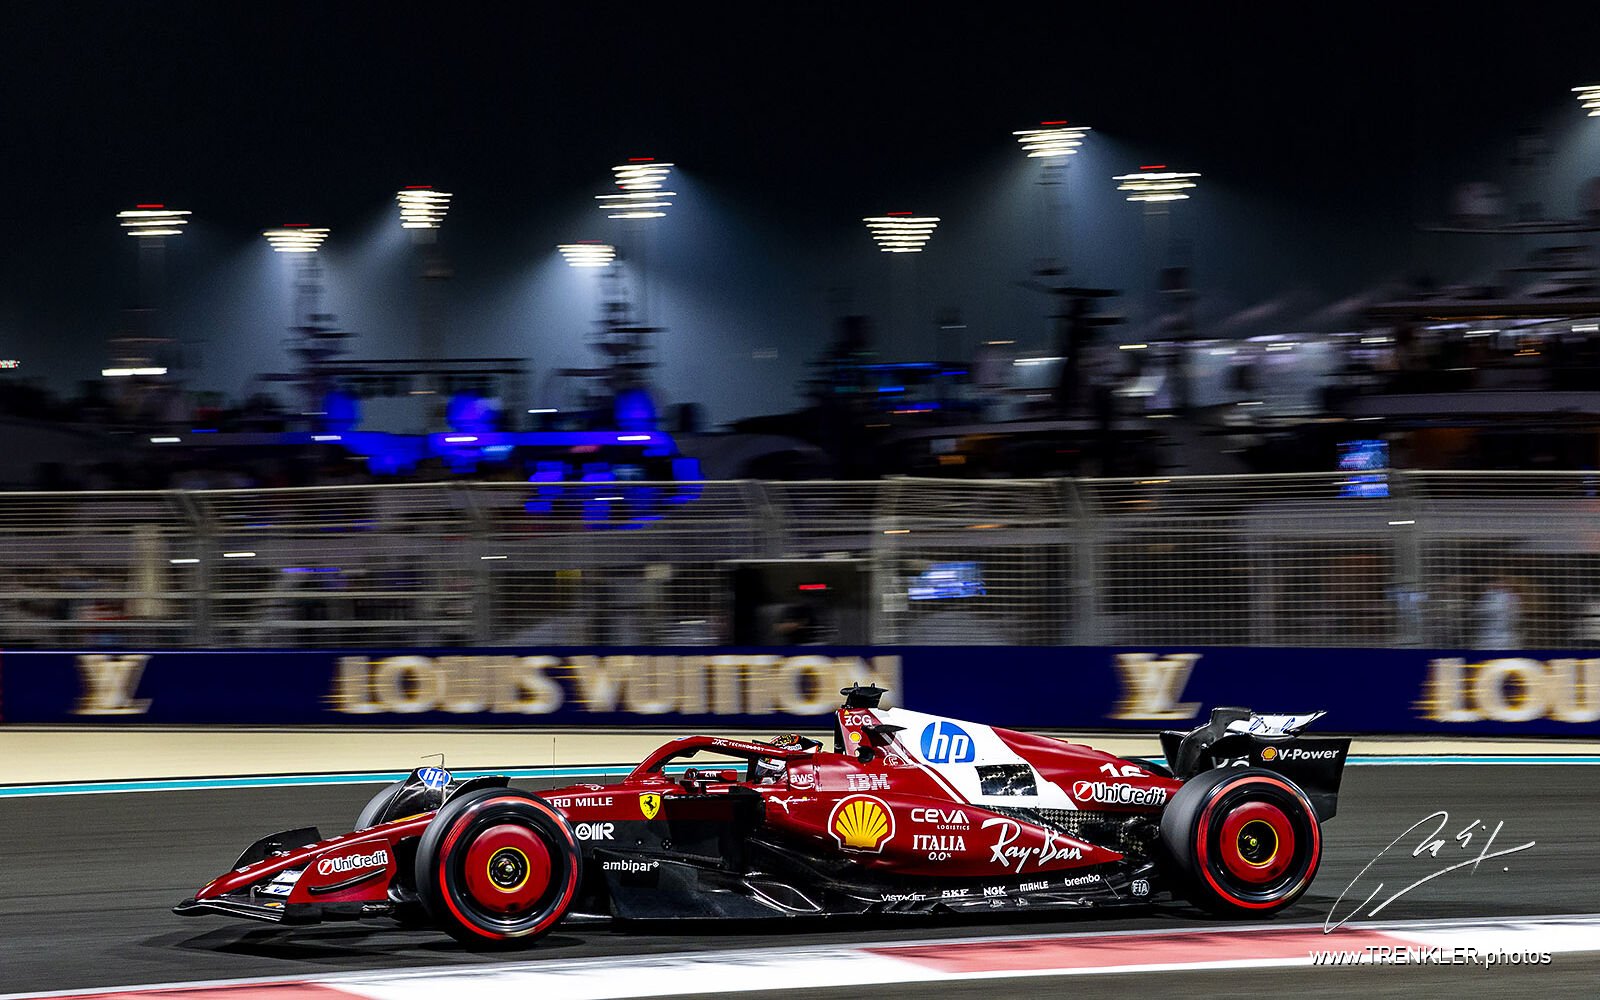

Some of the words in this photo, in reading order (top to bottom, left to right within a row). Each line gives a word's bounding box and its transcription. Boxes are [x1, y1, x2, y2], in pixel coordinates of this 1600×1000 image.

[328, 655, 563, 714] LOUIS
[1278, 748, 1339, 760] V-Power
[790, 773, 814, 783] aws
[846, 773, 891, 791] IBM
[1093, 782, 1167, 806] UniCredit
[575, 797, 613, 807] MILLE
[912, 834, 966, 851] ITALIA
[333, 850, 388, 873] UniCredit
[602, 860, 652, 873] ambipar
[1020, 881, 1049, 892] MAHLE
[1064, 874, 1100, 887] brembo
[942, 889, 969, 898] SKF
[983, 886, 1006, 896] NGK
[1132, 881, 1148, 894] FIA
